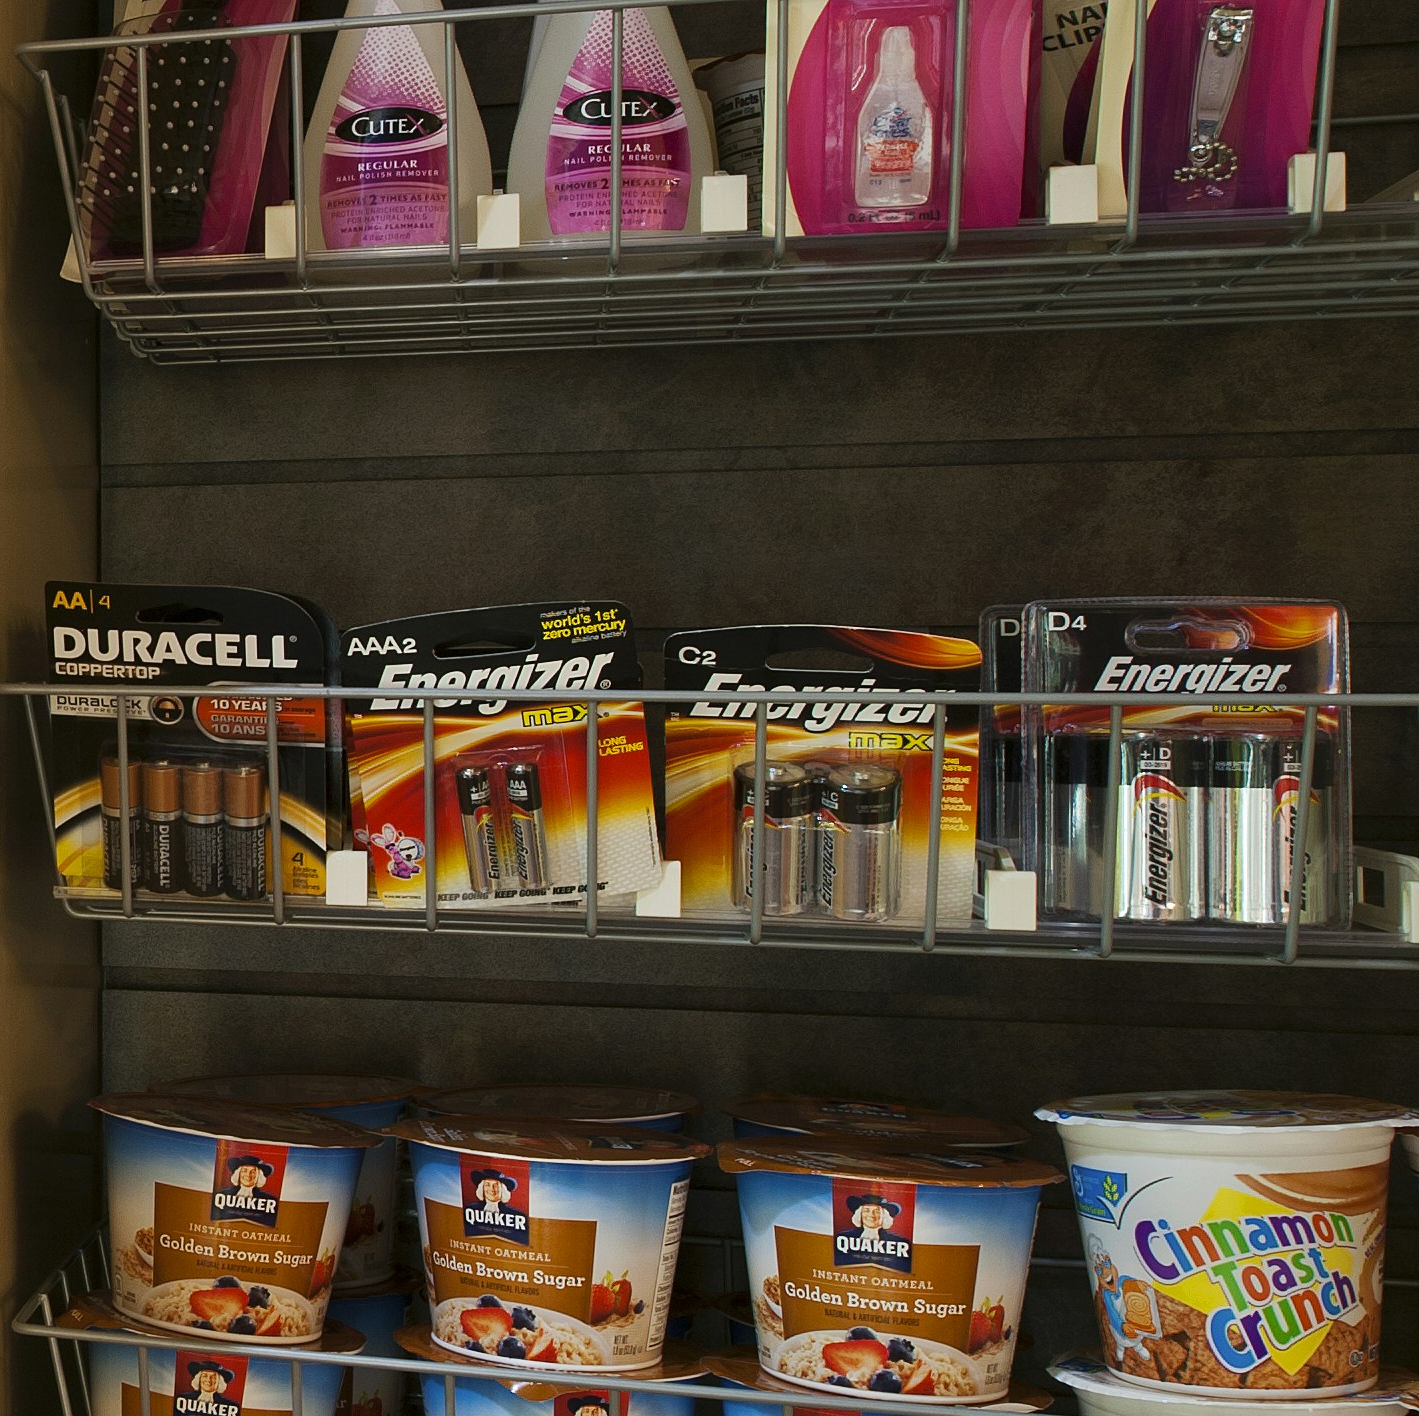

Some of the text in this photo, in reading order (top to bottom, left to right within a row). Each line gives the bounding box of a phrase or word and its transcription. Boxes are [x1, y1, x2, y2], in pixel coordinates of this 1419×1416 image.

[351, 114, 429, 137] CUTEX
[357, 160, 418, 172] REGULAR
[359, 171, 392, 180] POLISH
[396, 169, 440, 177] REMOVER
[52, 590, 87, 611] AA
[542, 614, 591, 630] world's
[543, 618, 626, 641] zero mercury
[1048, 611, 1087, 632] D4
[53, 626, 298, 669] DURACELL
[678, 646, 717, 666] C2
[55, 662, 160, 679] COPPERTOP
[1094, 656, 1291, 694] Energizer
[370, 651, 615, 716] Energizer
[211, 699, 229, 711] 10
[690, 673, 956, 733] Energizer
[211, 724, 267, 736] 10 ANS
[849, 731, 935, 750] max
[598, 736, 626, 748] LONG
[599, 741, 644, 757] LASTING
[159, 824, 170, 888] DURACELL
[1145, 801, 1174, 906] Energizer
[821, 830, 837, 907] Energizer
[214, 1193, 276, 1214] QUAKER
[465, 1208, 526, 1231] QUAKER
[189, 1222, 291, 1243] INSTANT OATMEAL
[159, 1234, 313, 1268] Golden Brown Sugar
[837, 1235, 909, 1258] QUAKER
[1134, 1213, 1354, 1281] Cinnamon
[1211, 1249, 1330, 1313] Toast
[1208, 1273, 1356, 1373] Crunch
